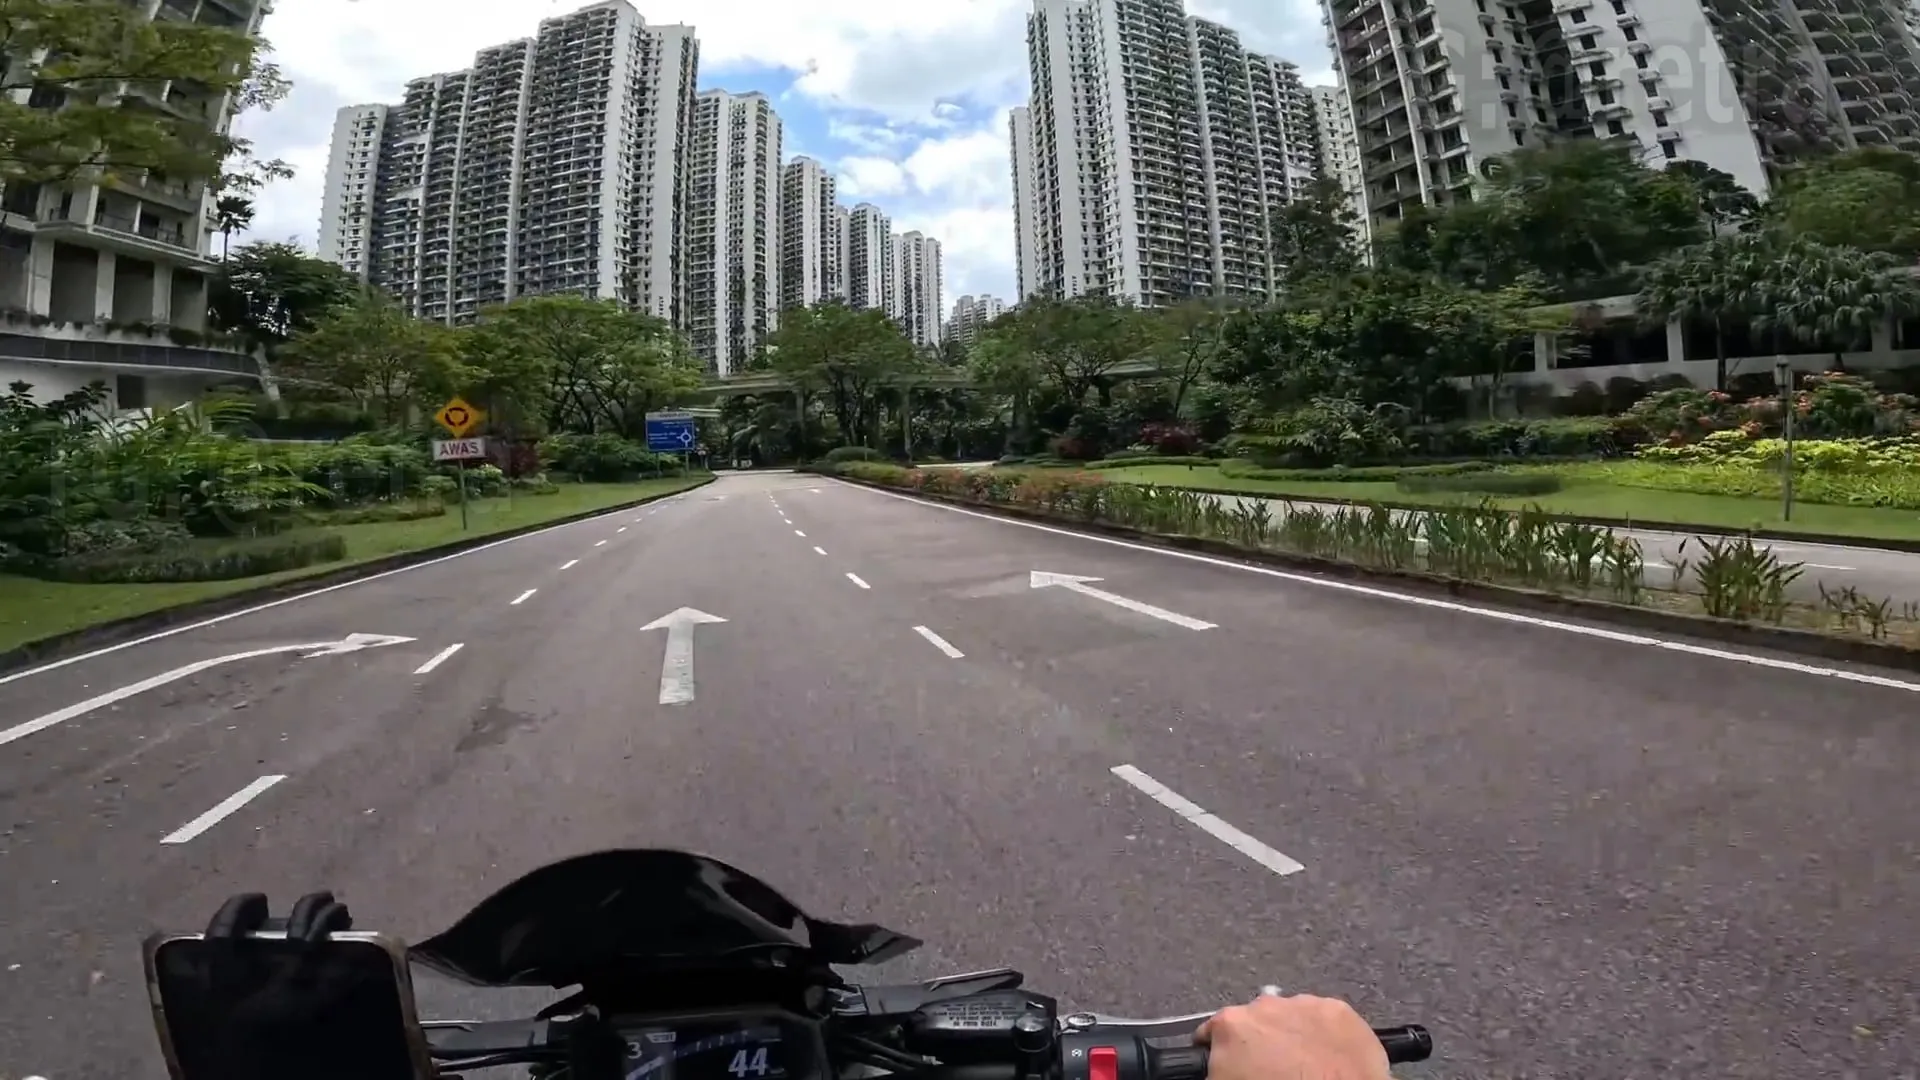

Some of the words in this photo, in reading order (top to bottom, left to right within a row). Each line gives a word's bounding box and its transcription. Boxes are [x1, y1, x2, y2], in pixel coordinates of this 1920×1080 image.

[439, 441, 480, 456] AWAS
[627, 1041, 643, 1060] 3
[728, 1047, 768, 1078] 44
